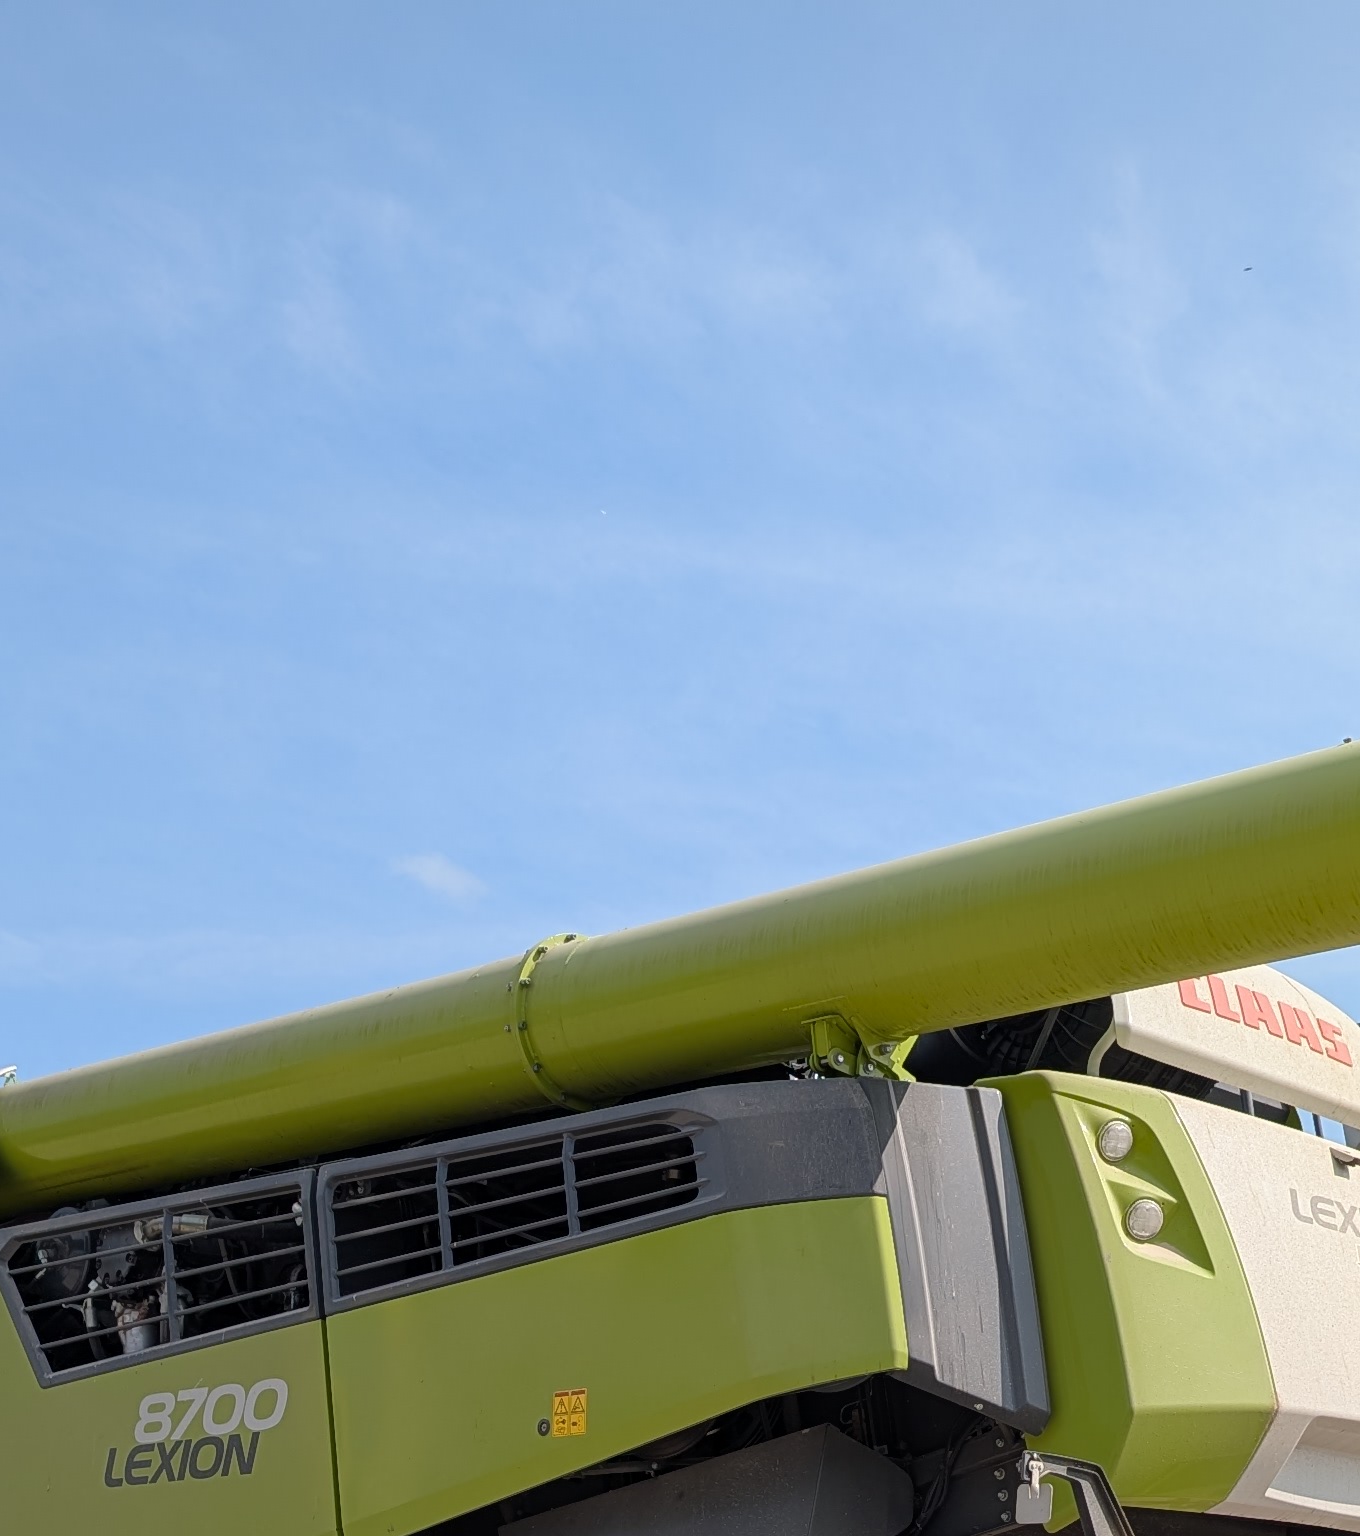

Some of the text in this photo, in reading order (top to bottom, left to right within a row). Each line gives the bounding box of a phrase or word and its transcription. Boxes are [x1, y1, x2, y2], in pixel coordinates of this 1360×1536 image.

[1177, 975, 1354, 1067] CLAAS
[134, 1377, 288, 1444] 8700
[104, 1431, 261, 1488] LEXION
